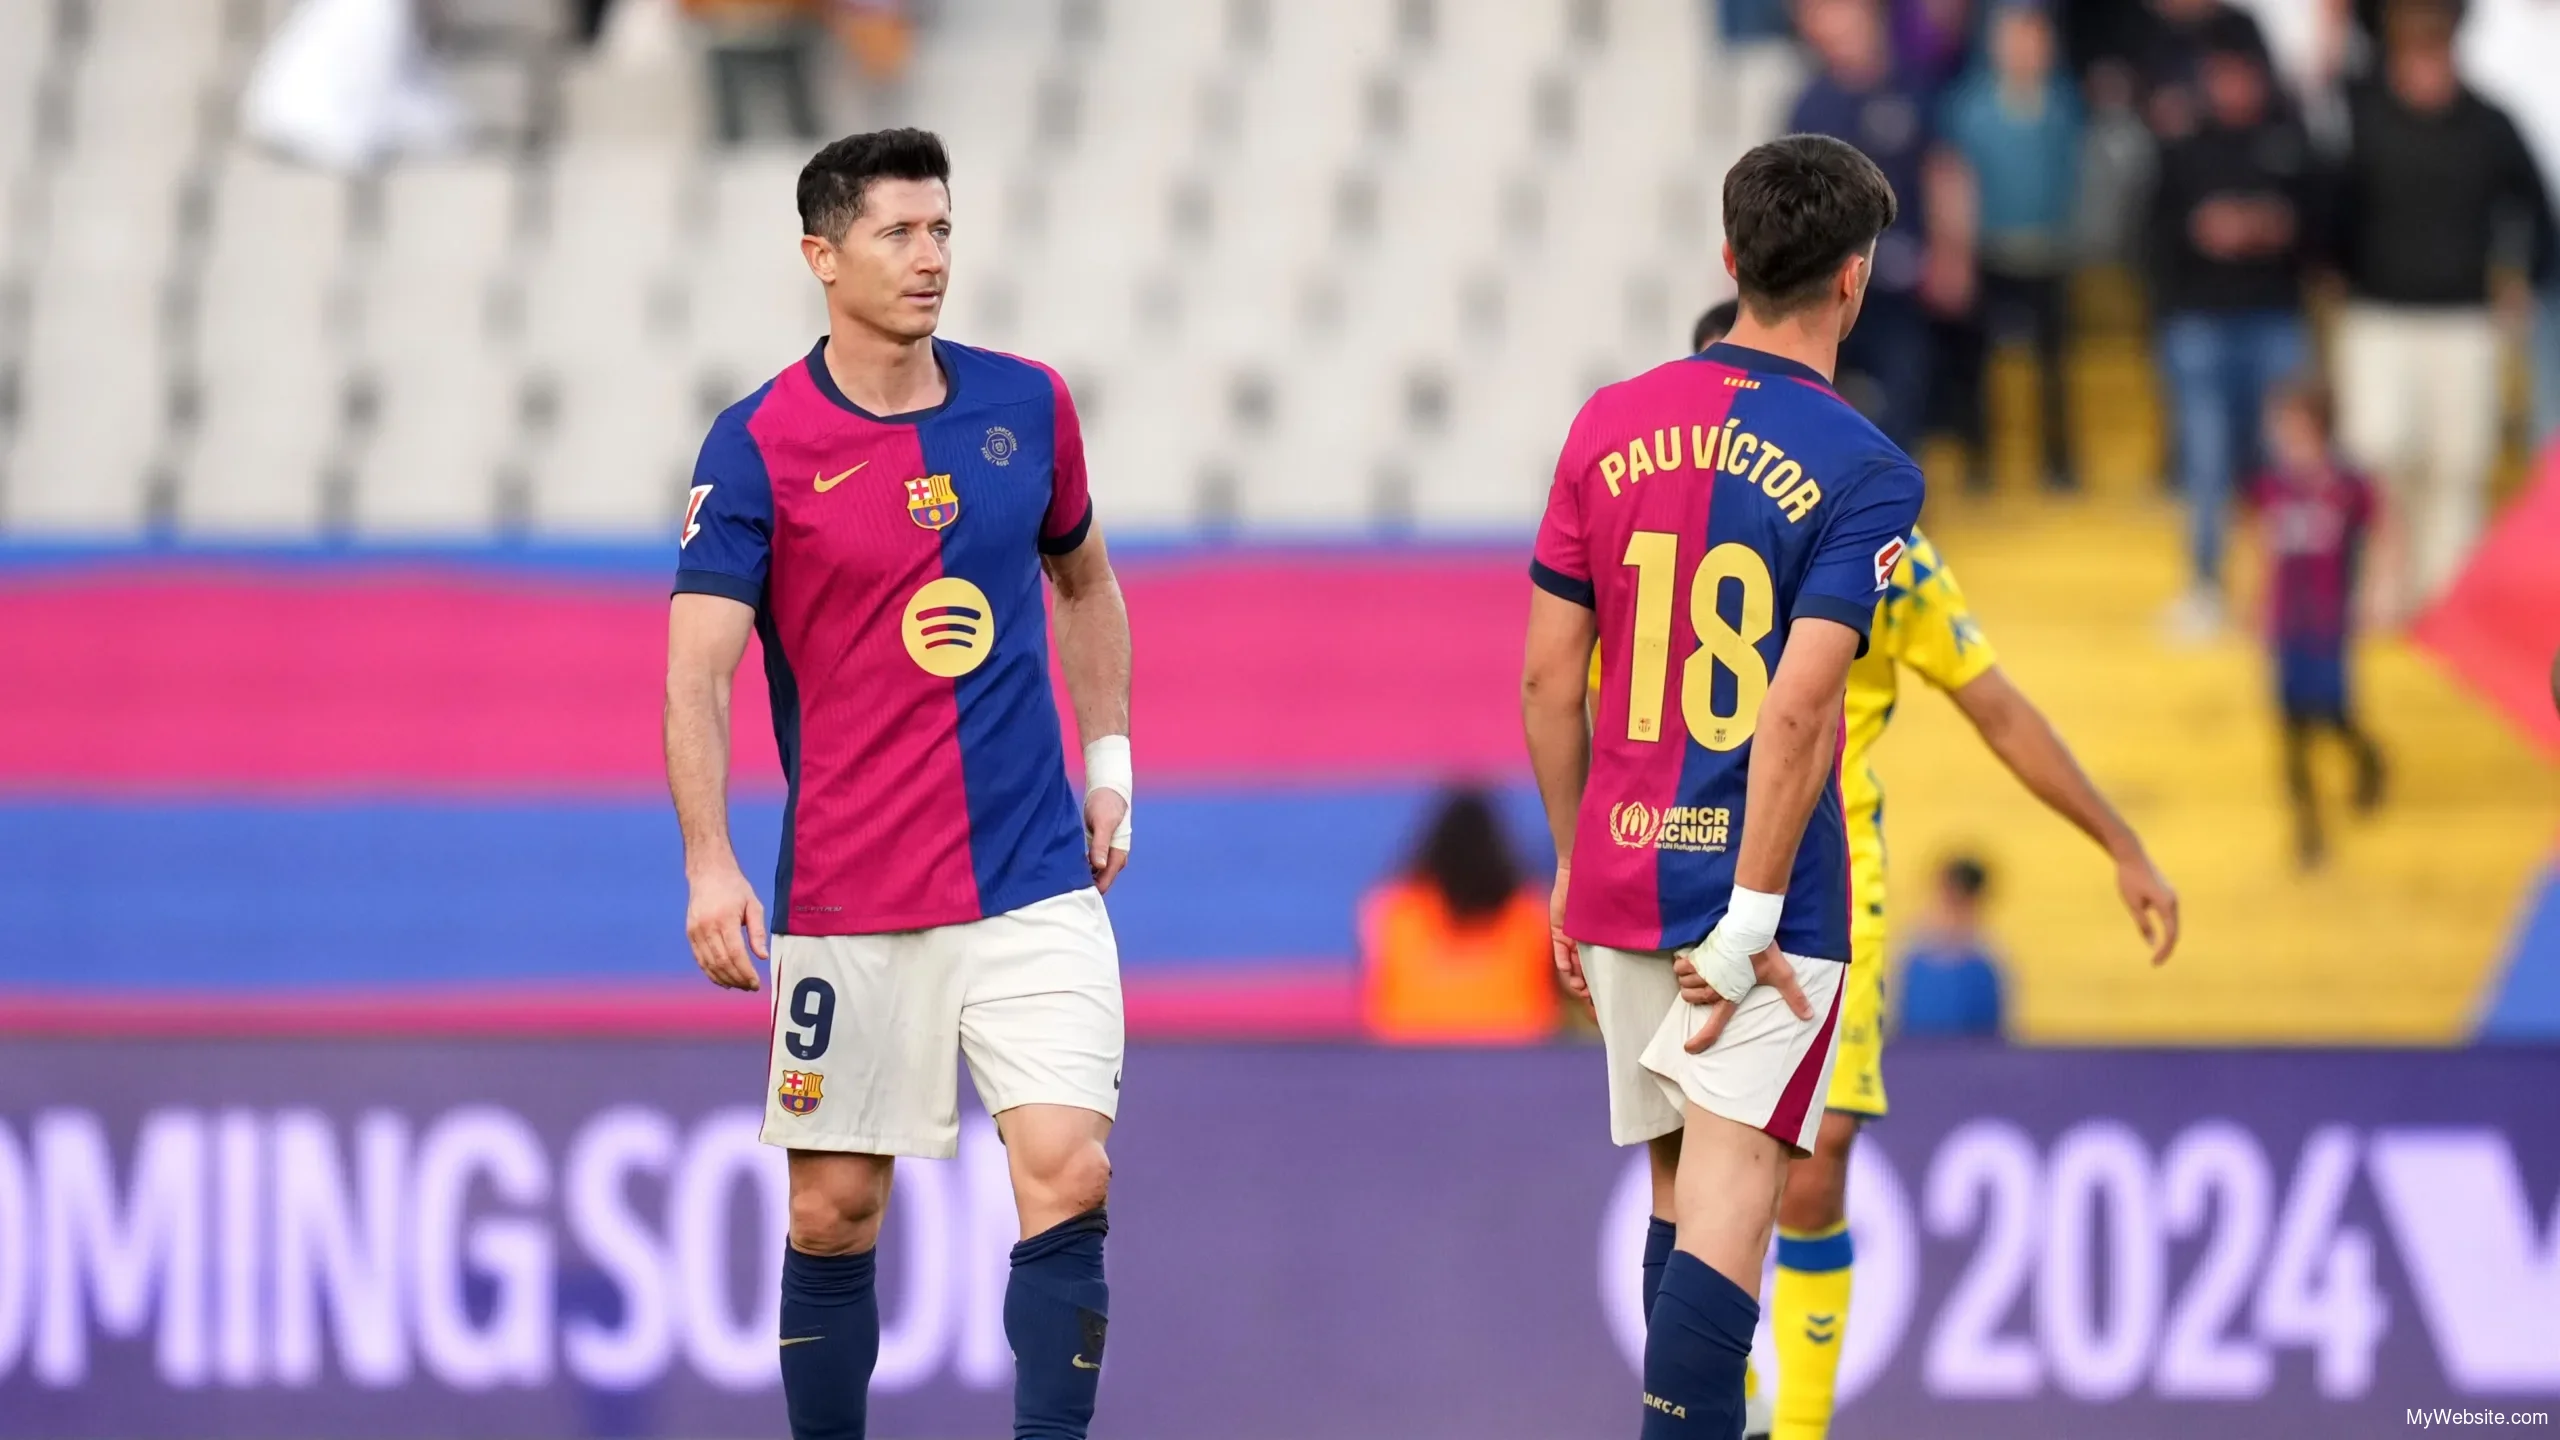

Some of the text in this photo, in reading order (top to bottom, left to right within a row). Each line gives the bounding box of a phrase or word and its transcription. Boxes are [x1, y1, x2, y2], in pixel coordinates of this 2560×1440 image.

[1599, 418, 1821, 524] PAU VÍCTOR
[1622, 531, 1773, 752] 18
[1655, 823, 1728, 844] ACNUR
[1662, 806, 1730, 826] UNHCR
[784, 976, 836, 1061] 9
[1922, 1120, 2386, 1402] 2024
[1643, 1391, 1686, 1419] ARÇA
